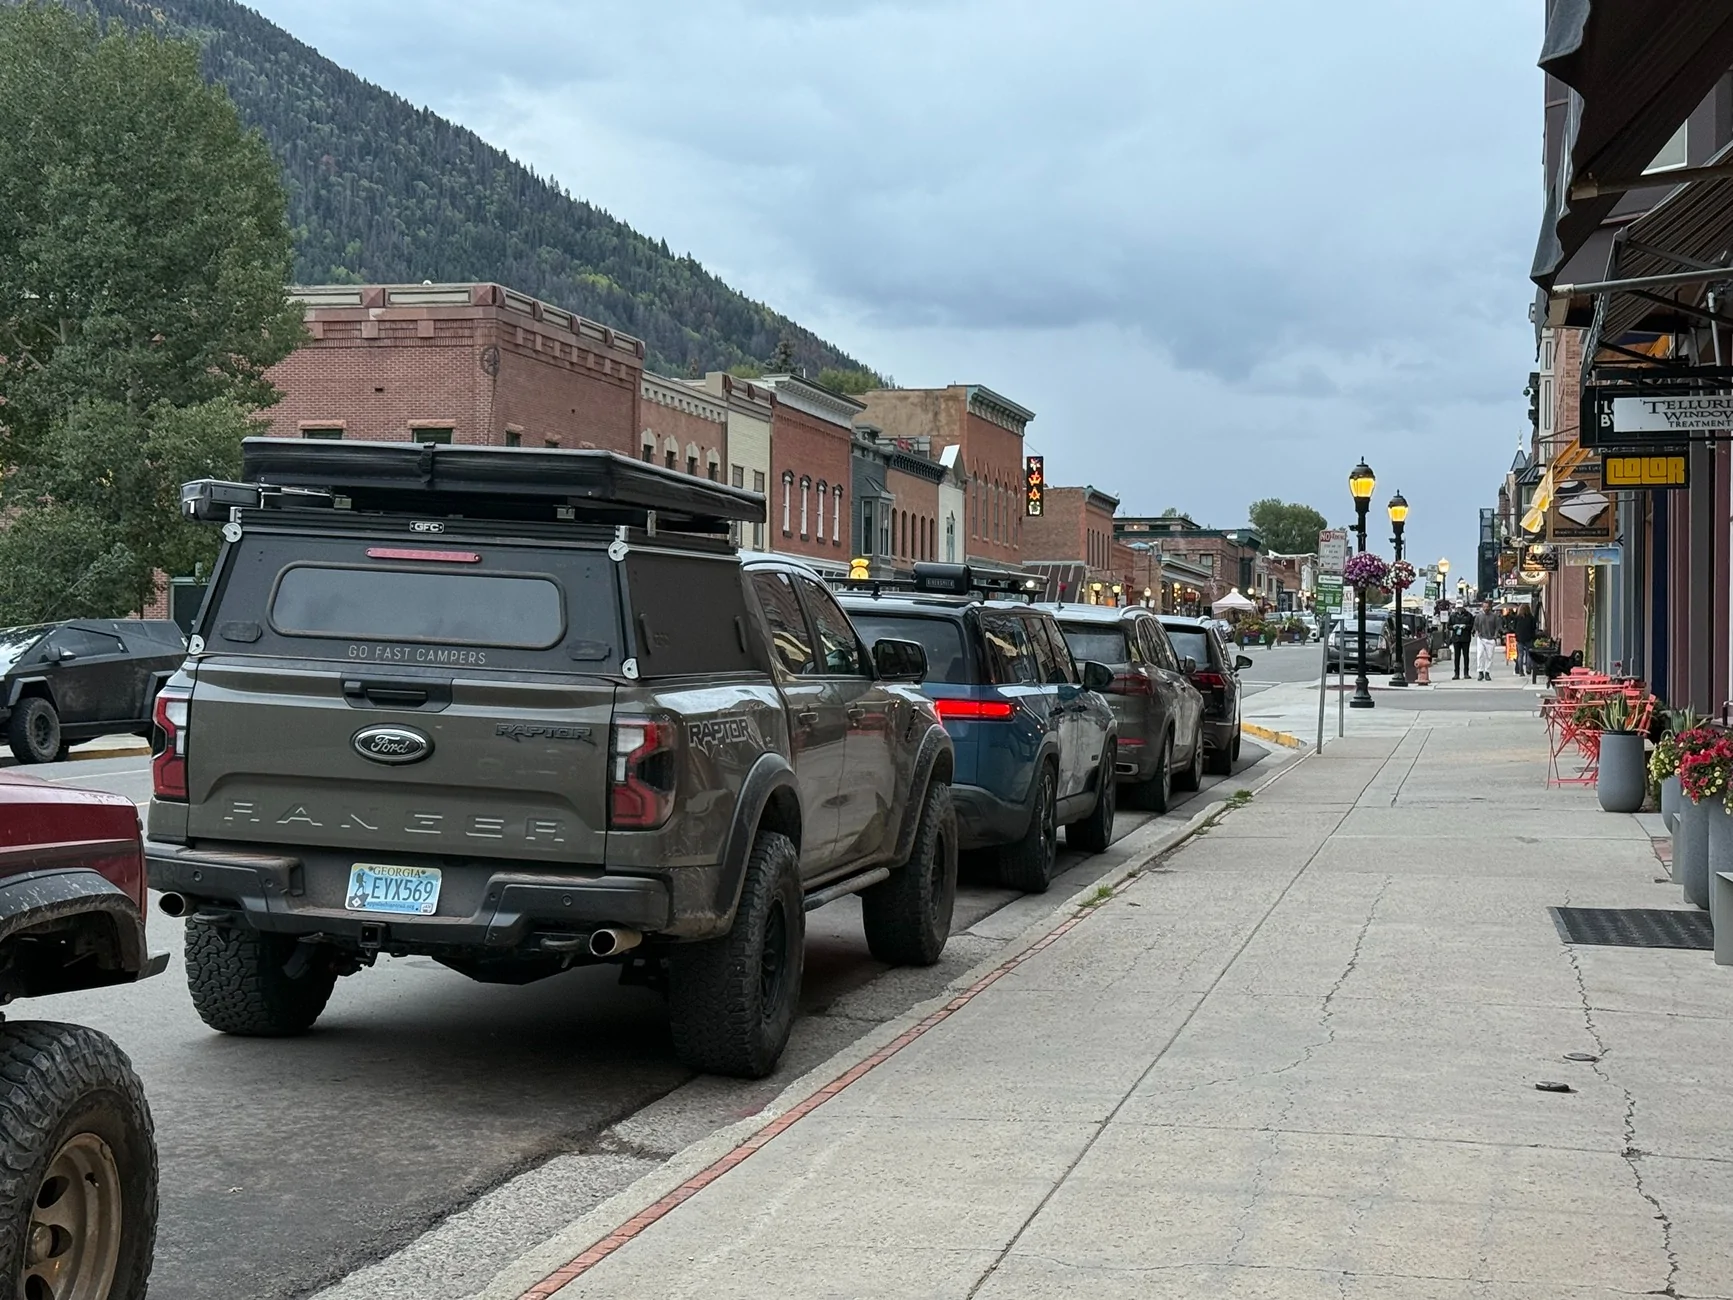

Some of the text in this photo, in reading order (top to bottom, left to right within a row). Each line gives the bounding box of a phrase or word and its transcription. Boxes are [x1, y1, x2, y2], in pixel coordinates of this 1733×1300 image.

[1668, 420, 1731, 428] TREATMENT
[414, 522, 439, 531] GFC
[348, 645, 486, 664] GO FAST CAMPERS
[370, 734, 410, 753] Ford
[495, 723, 596, 746] RAPTOR
[687, 716, 752, 755] RAPTOR
[224, 801, 566, 843] RANGER
[373, 865, 421, 878] GEORGIA
[371, 877, 434, 902] EYX569
